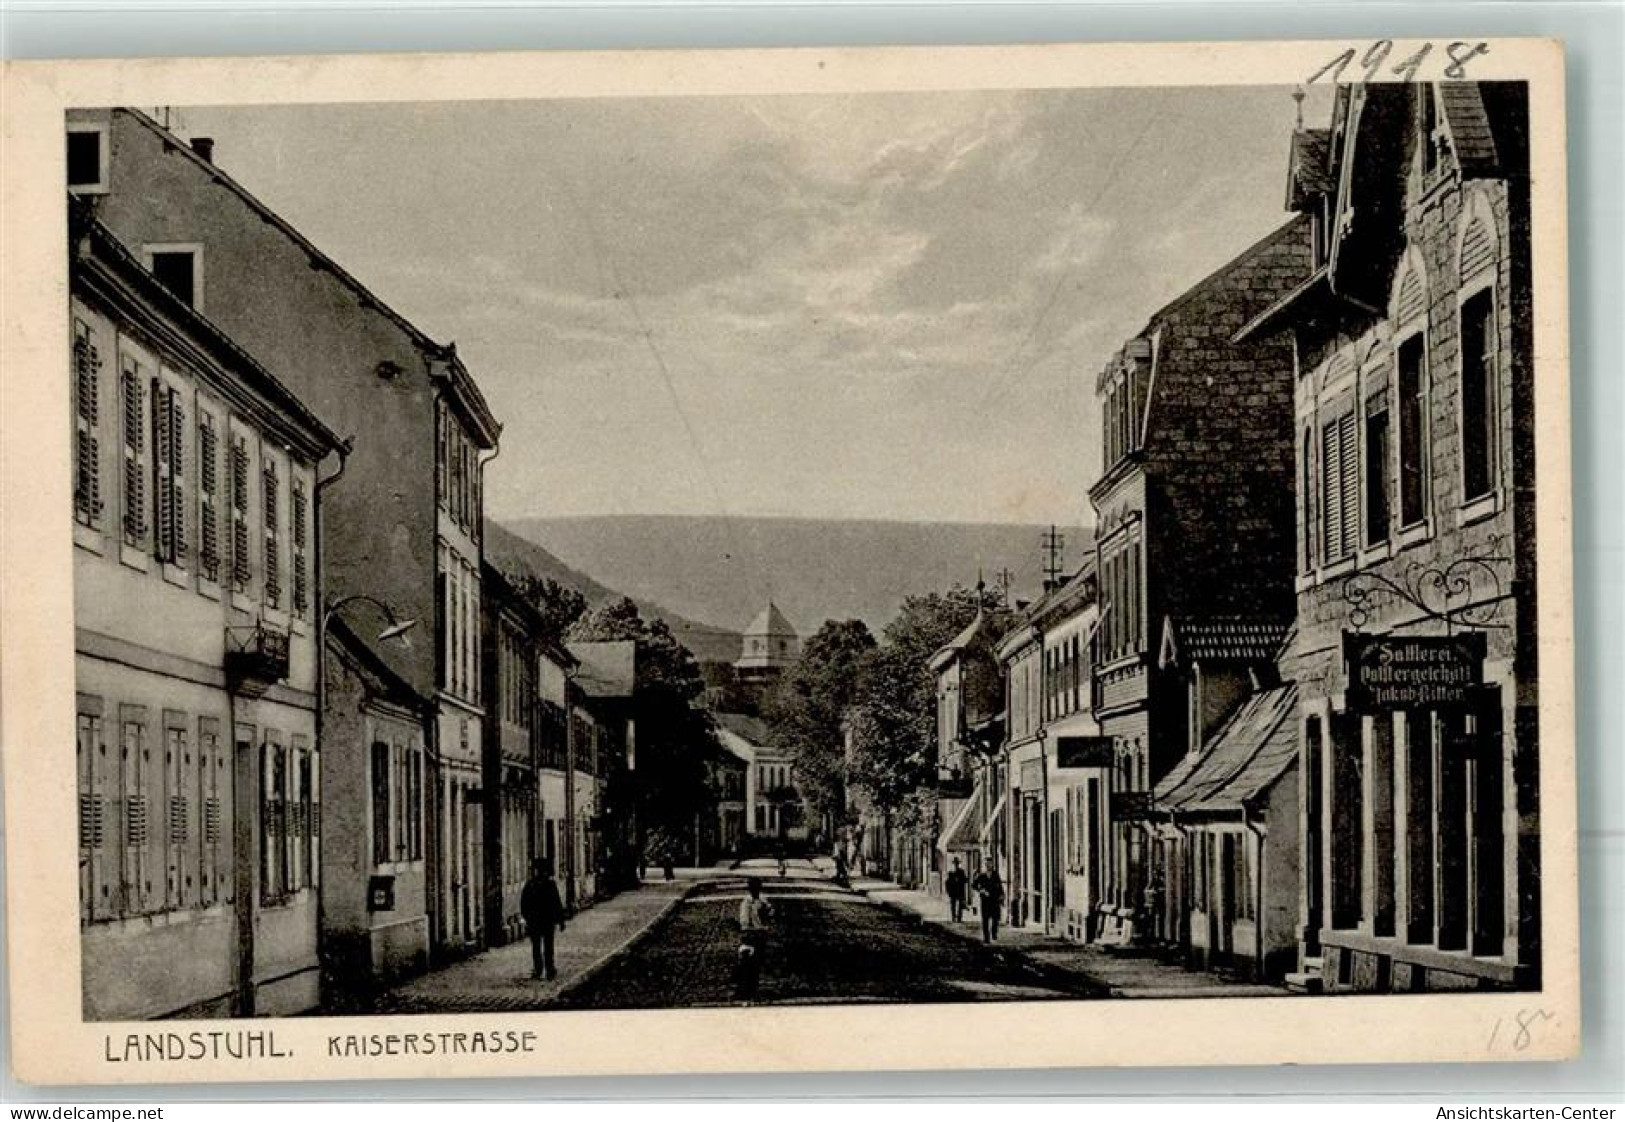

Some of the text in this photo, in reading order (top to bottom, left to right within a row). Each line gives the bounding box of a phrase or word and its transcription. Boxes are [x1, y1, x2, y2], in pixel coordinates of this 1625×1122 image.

[1307, 39, 1489, 84] 1918
[104, 1030, 538, 1062] LANDSTUHL. KAISERSTRASSE
